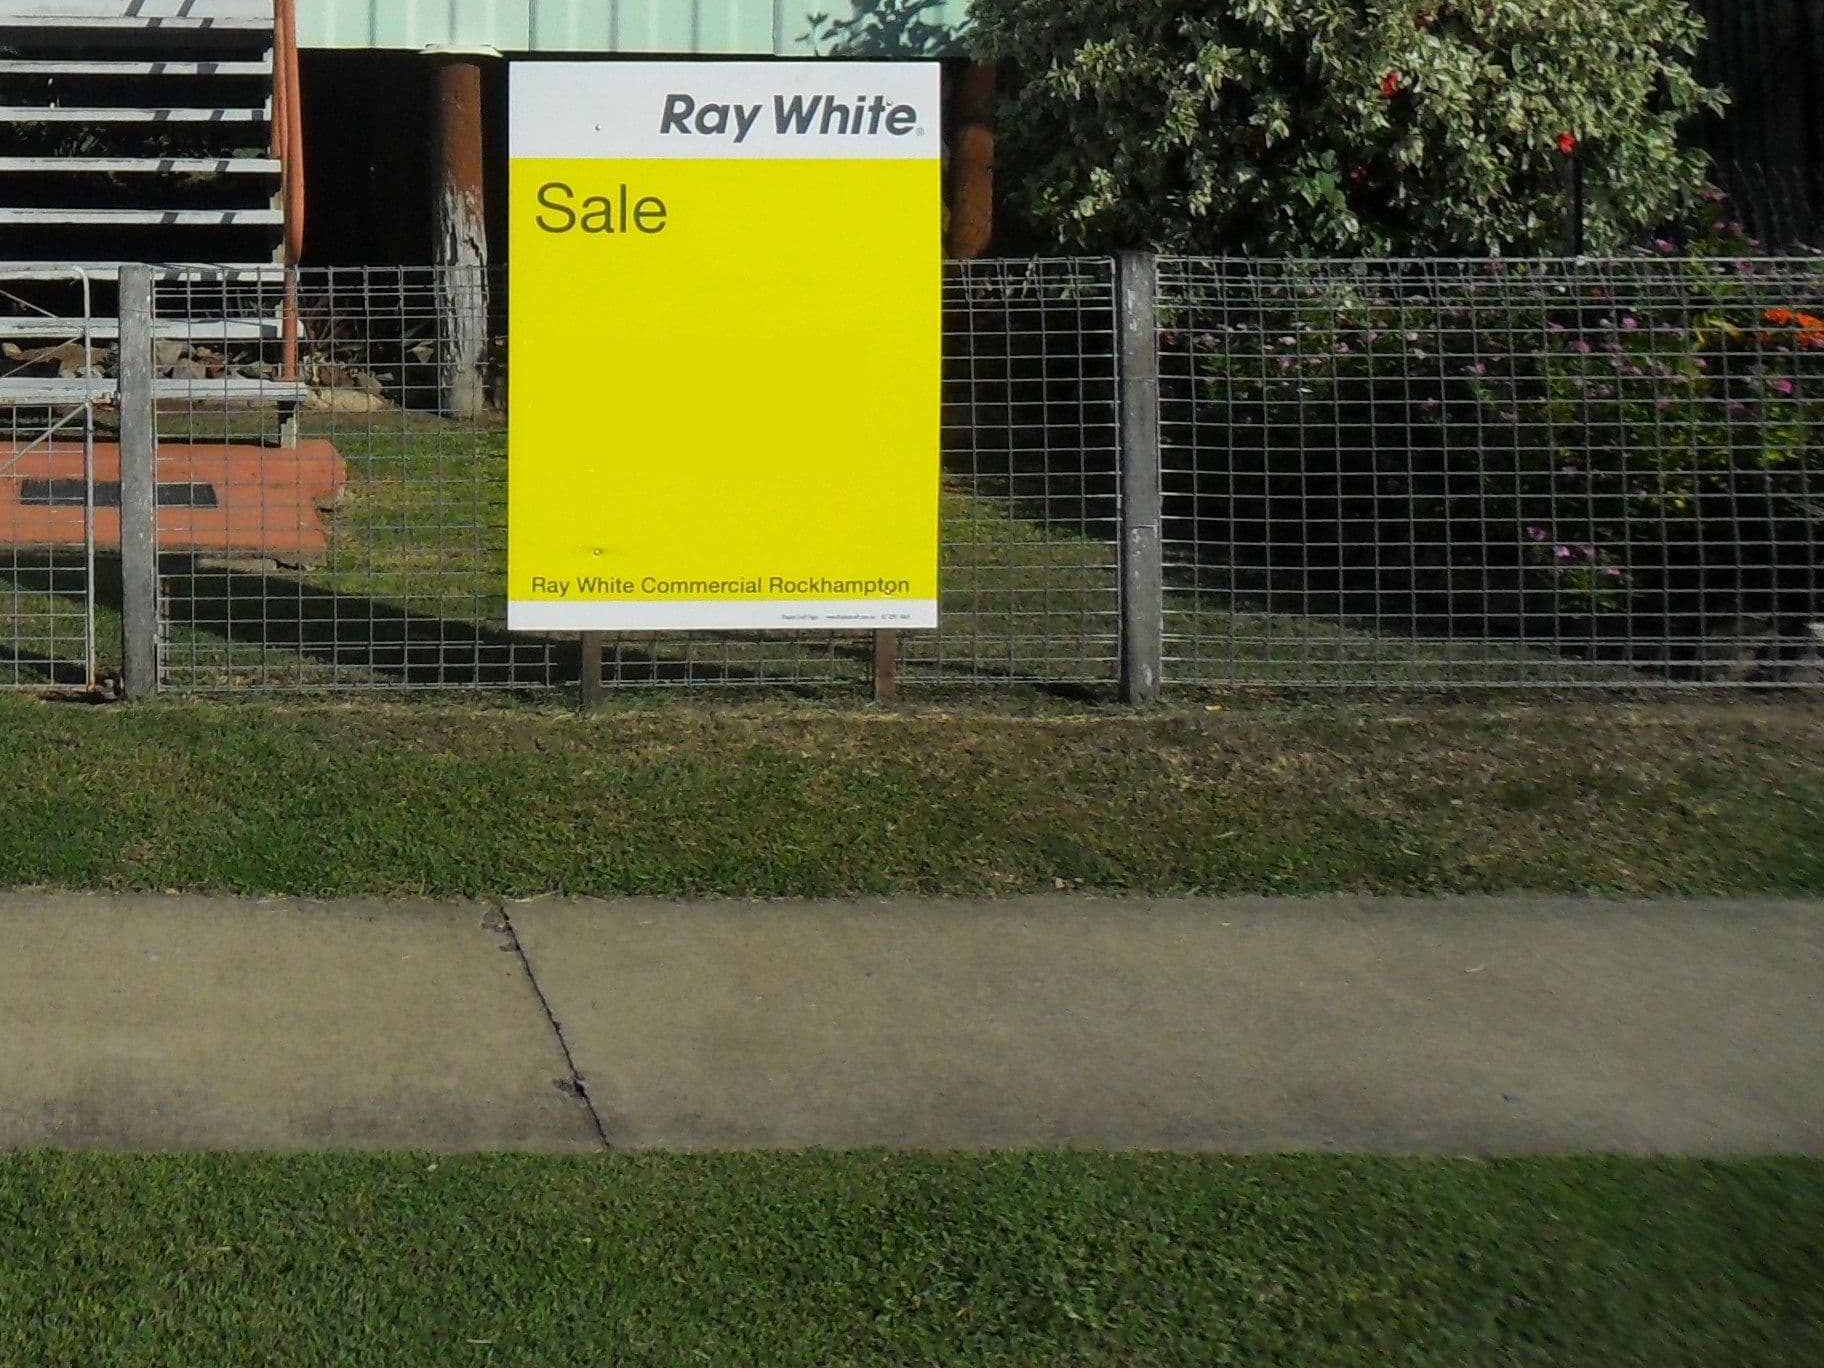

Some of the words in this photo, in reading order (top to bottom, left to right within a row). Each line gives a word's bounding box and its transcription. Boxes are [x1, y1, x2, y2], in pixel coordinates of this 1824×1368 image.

[659, 93, 762, 144] Ray
[773, 94, 918, 137] White
[534, 181, 668, 234] Sale
[531, 576, 570, 598] Ray
[577, 576, 635, 595] White
[640, 576, 763, 595] Commercial
[769, 576, 911, 598] Rockhampton
